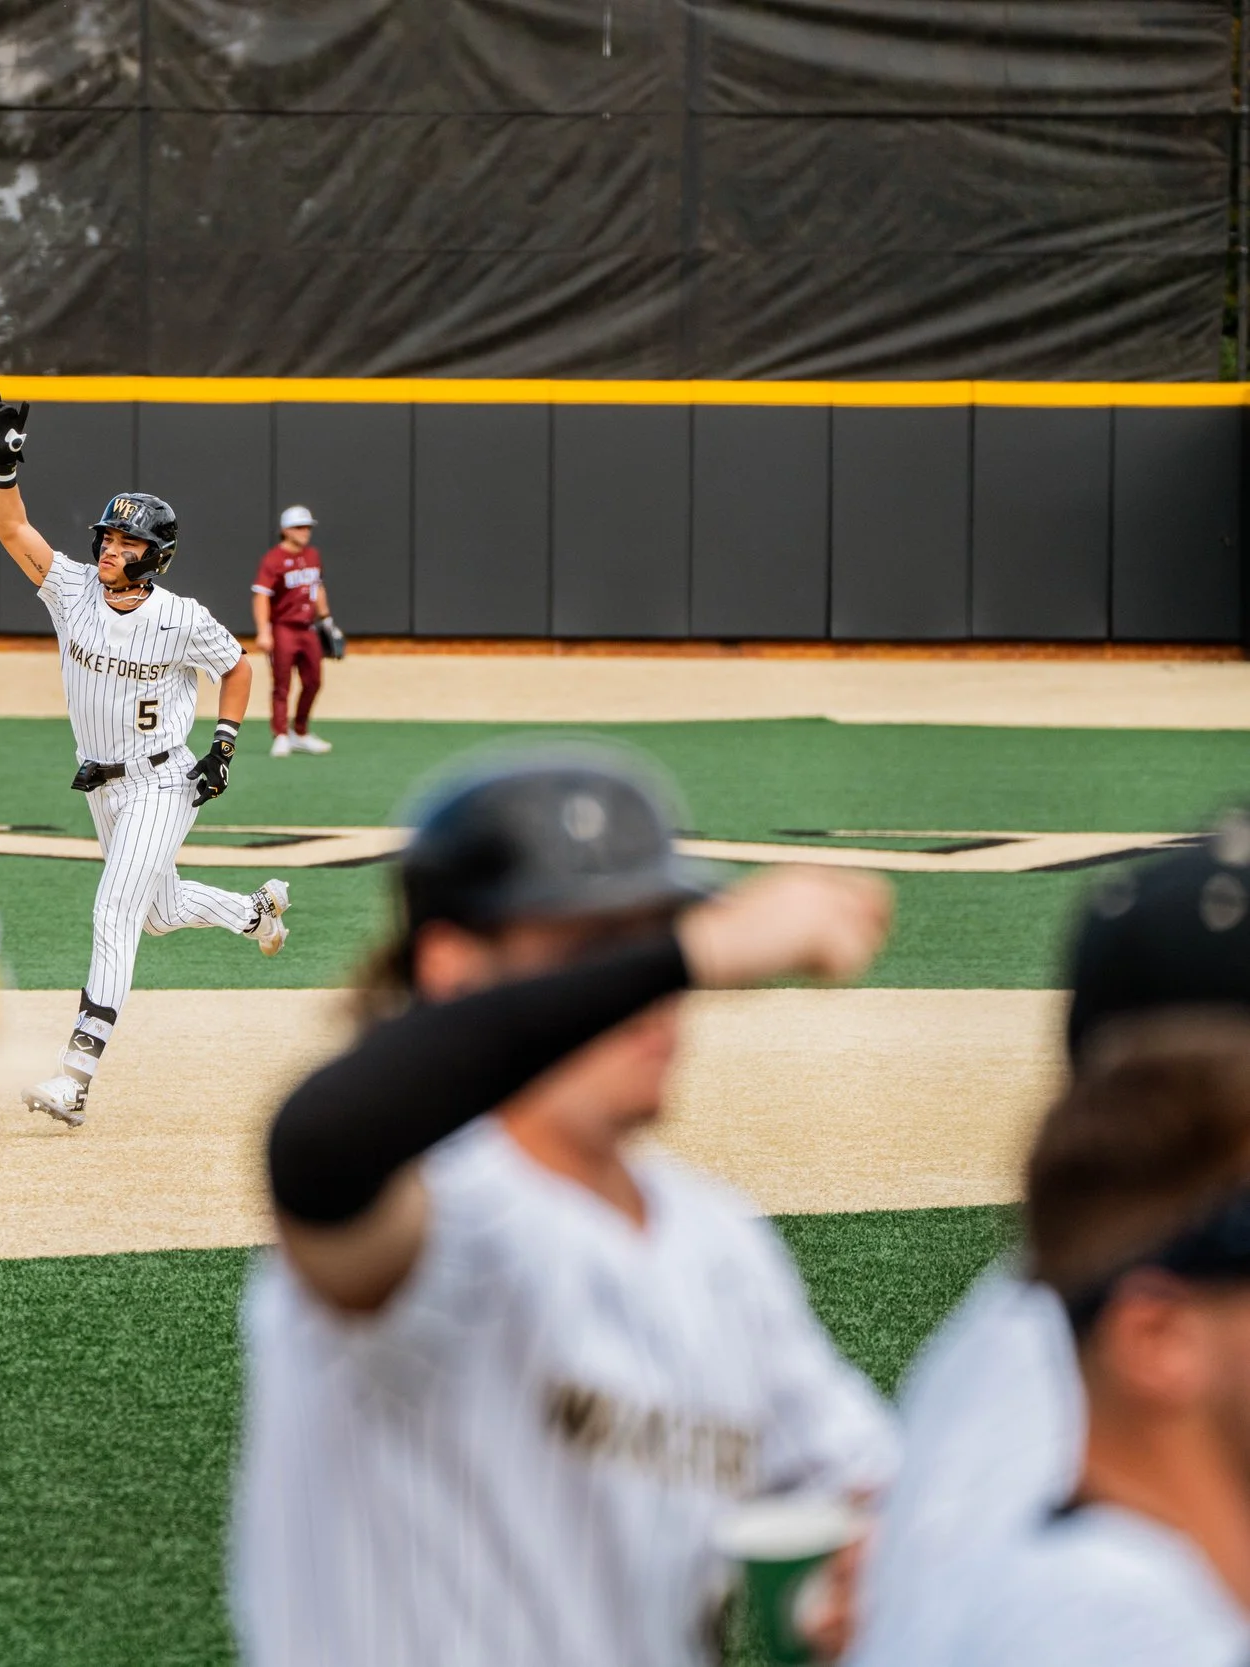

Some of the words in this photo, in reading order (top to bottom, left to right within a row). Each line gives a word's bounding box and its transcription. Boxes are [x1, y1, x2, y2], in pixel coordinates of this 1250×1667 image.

[112, 498, 138, 519] WF
[68, 639, 105, 672] WAKE
[106, 657, 170, 681] FOREST
[136, 698, 160, 732] 5
